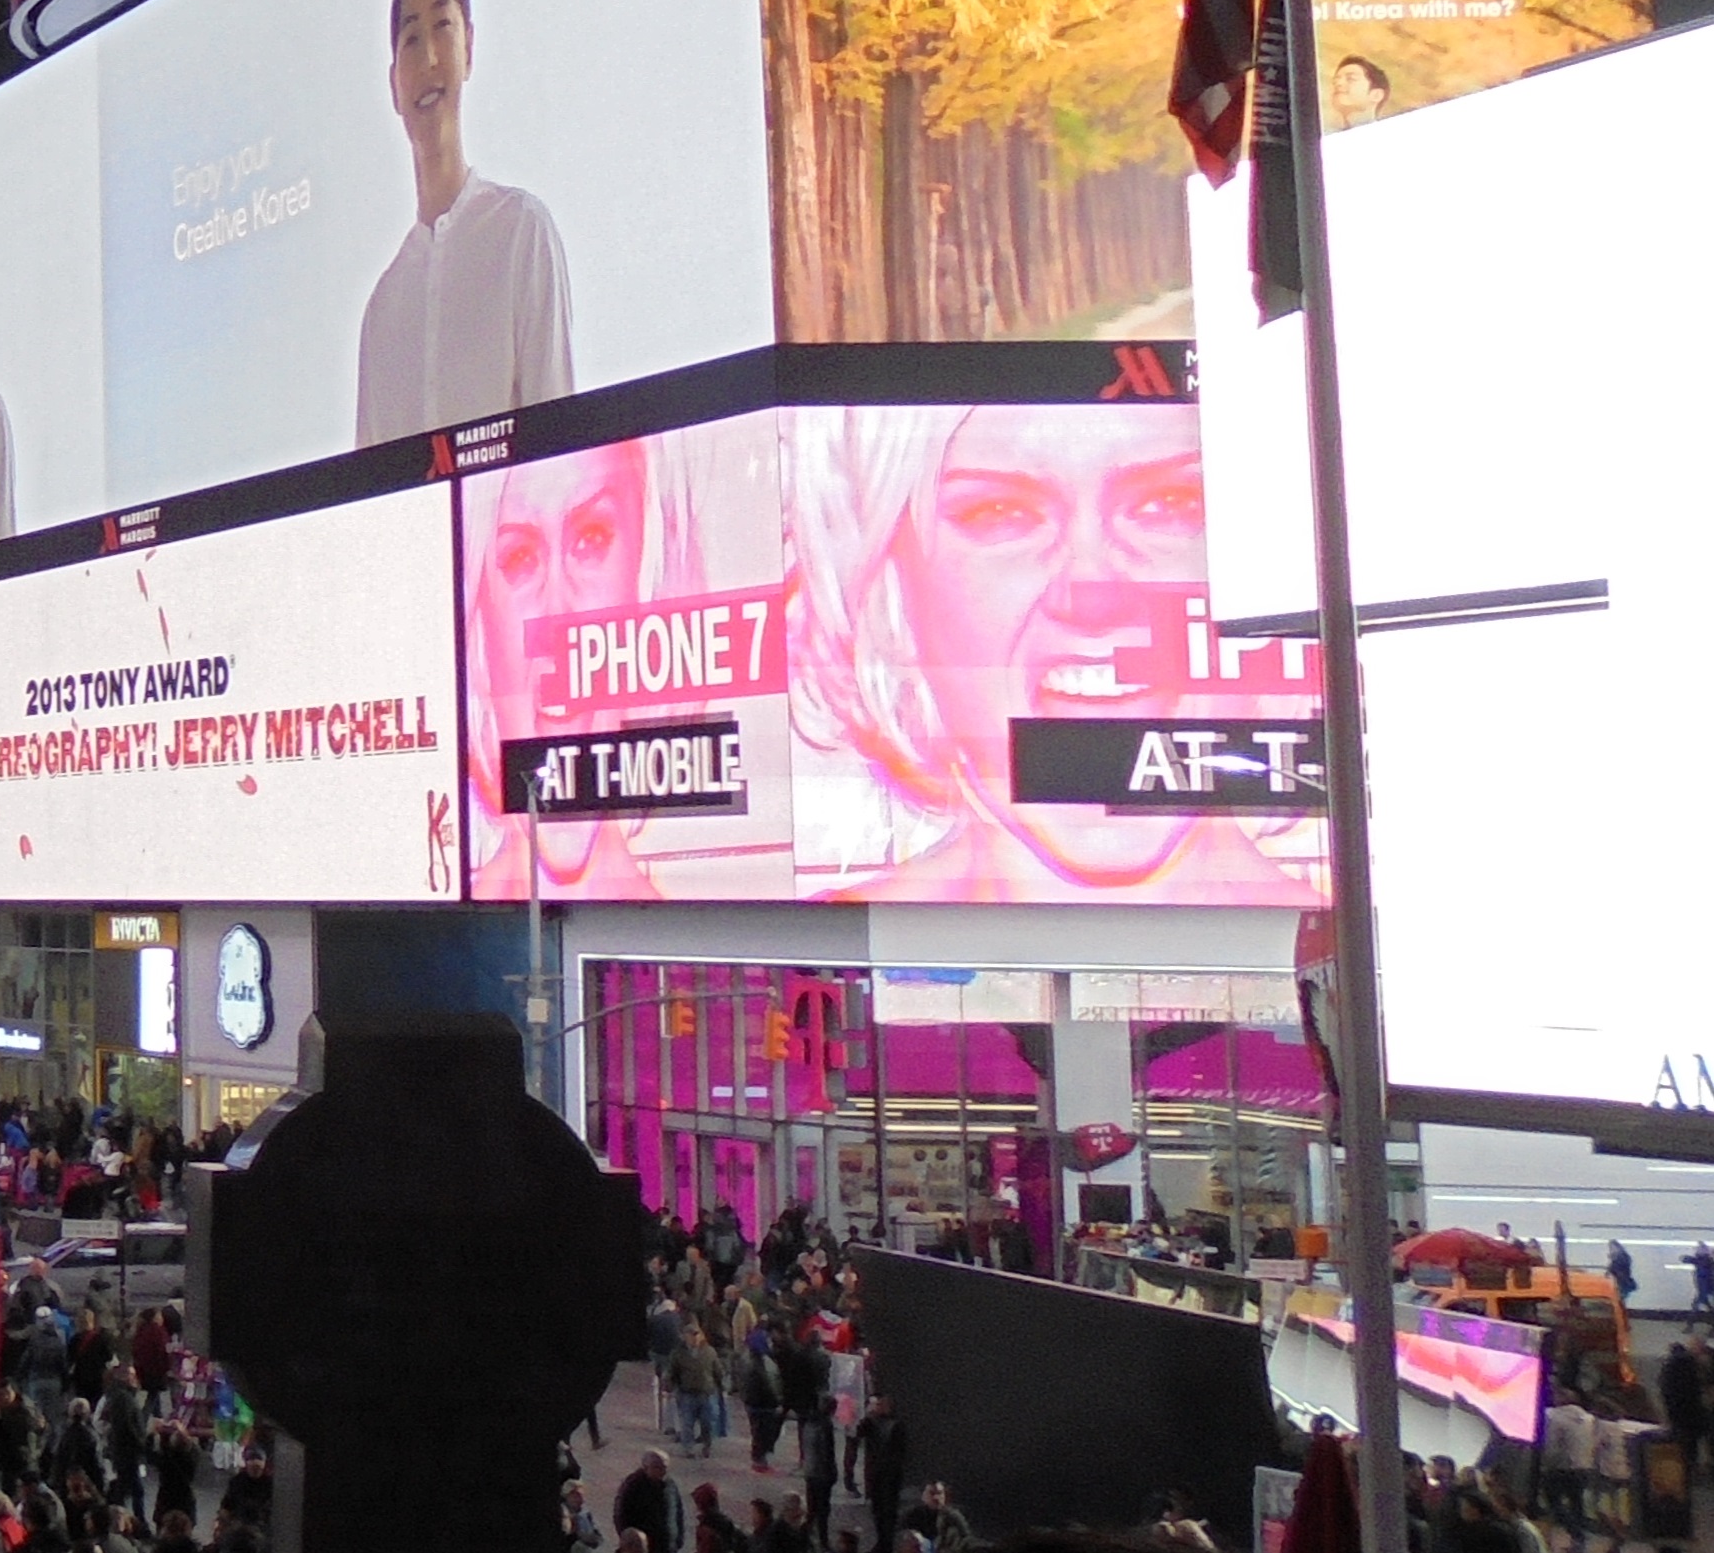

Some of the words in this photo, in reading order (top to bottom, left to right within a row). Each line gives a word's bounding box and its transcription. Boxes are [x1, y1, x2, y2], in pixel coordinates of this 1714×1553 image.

[1336, 2, 1404, 19] Korea
[1409, 0, 1458, 18] with
[173, 201, 248, 263] Creative
[252, 175, 312, 229] Korea
[456, 418, 515, 448] MARRIOTT
[457, 442, 509, 468] MARQUIS
[568, 606, 731, 701] iPHONE
[739, 600, 769, 677] 7
[25, 673, 78, 717] 2013
[80, 665, 139, 711] TONY
[164, 711, 260, 771] JERRY
[263, 696, 438, 760] MITCHELL
[594, 732, 742, 799] T-MOBILE
